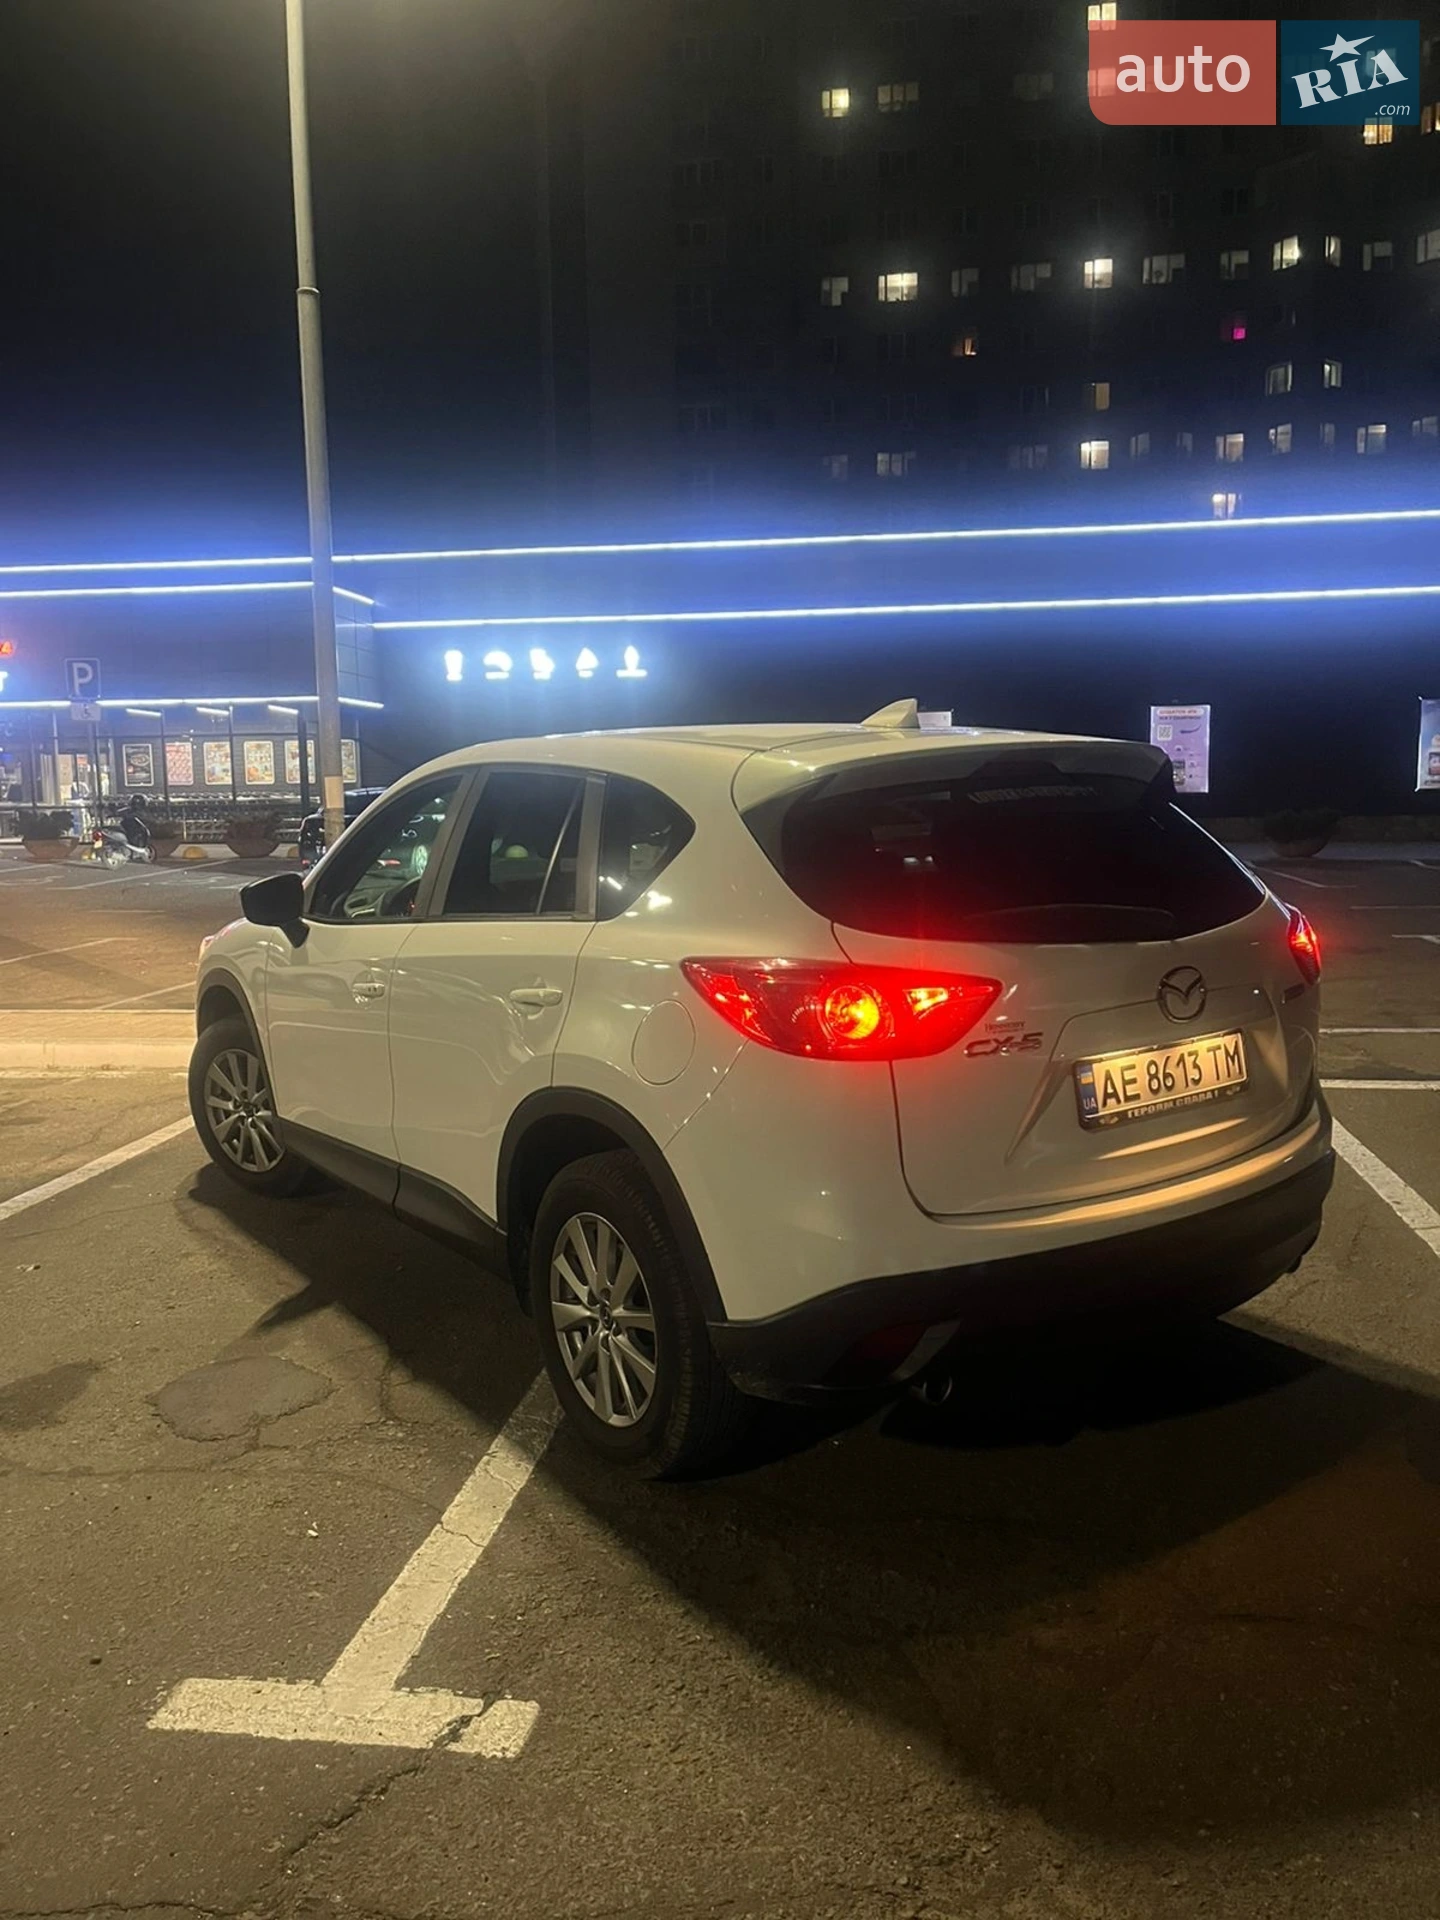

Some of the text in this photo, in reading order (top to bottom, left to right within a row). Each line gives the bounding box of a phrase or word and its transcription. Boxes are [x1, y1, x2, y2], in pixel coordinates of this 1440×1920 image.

[72, 662, 93, 697] P
[964, 1032, 1043, 1057] CX-5
[1102, 1039, 1244, 1108] AE 8613 TM
[1083, 1098, 1098, 1110] UA
[1127, 1101, 1174, 1118] ГЕРОЯМ
